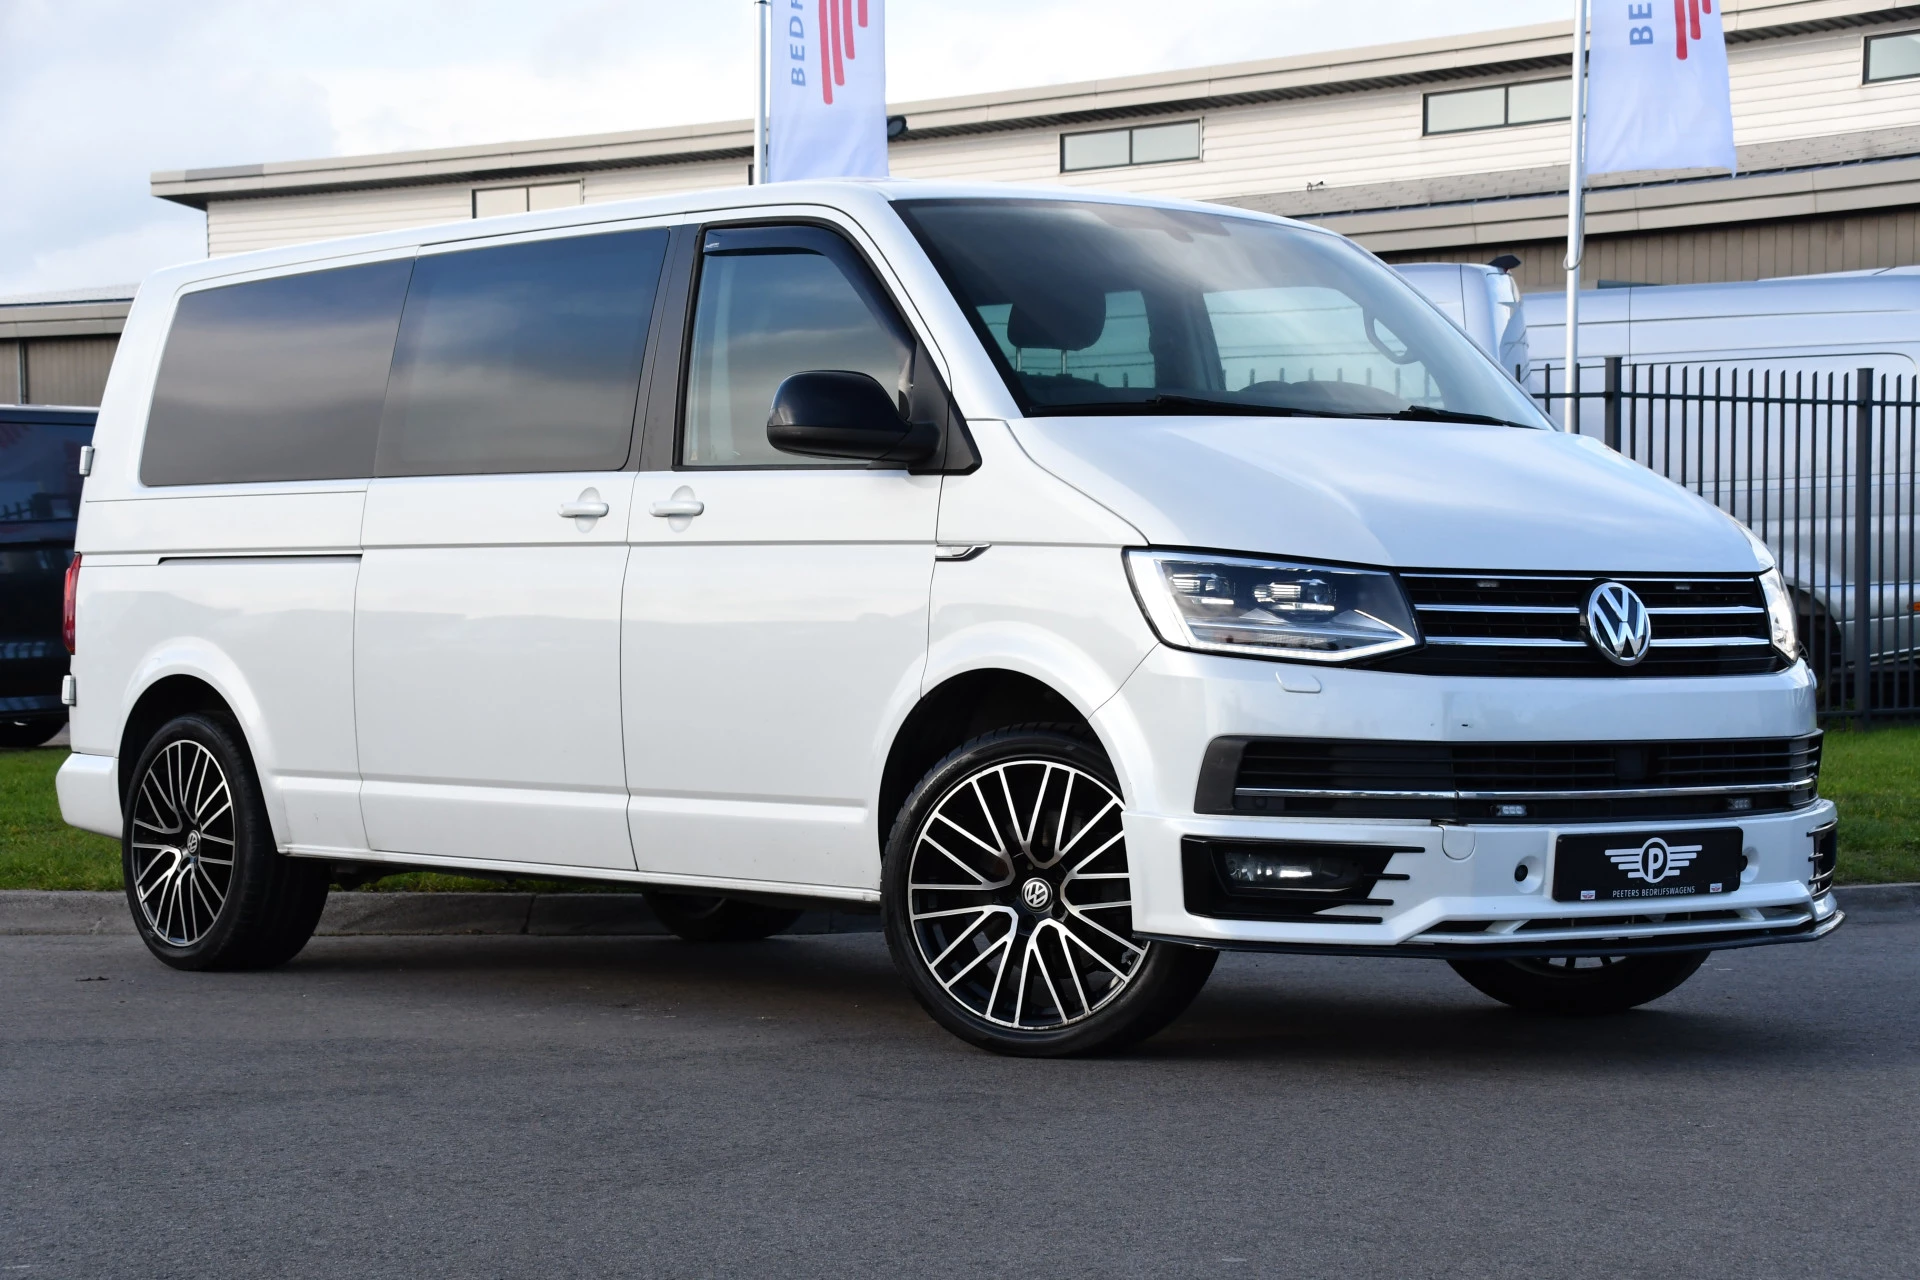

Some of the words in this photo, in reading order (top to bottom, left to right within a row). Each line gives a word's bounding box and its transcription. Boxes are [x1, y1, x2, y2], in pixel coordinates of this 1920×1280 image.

[1589, 583, 1651, 664] VW
[1648, 847, 1664, 880] P
[1024, 881, 1048, 907] VW
[1612, 889, 1640, 898] PEETERS
[1641, 885, 1696, 897] BEDRIJFSWAGENS
